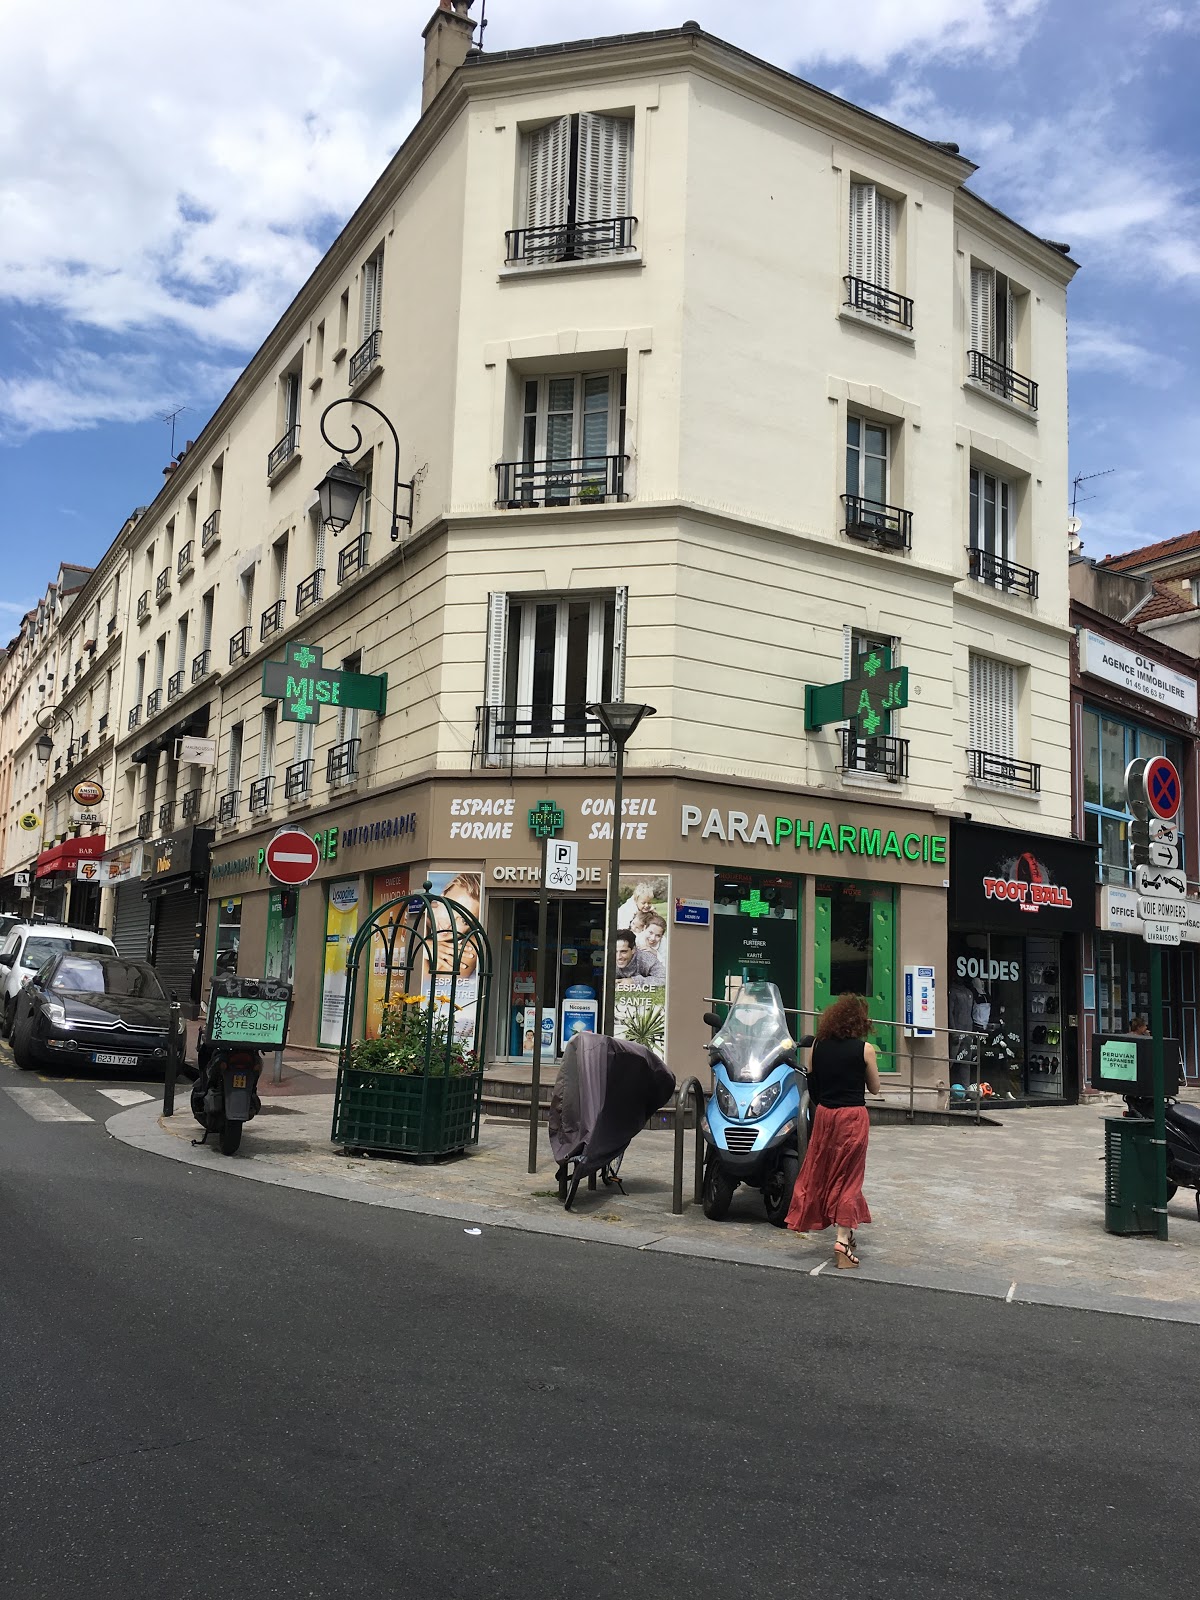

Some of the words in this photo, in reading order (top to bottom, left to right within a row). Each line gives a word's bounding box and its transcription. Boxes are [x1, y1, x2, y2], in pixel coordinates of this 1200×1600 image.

[1135, 656, 1156, 673] OLT
[1102, 654, 1135, 677] AGENCE
[1136, 669, 1186, 699] IMMOBILIERE
[1125, 677, 1133, 687] 01
[1133, 681, 1142, 691] 45
[450, 798, 516, 816] ESPACE
[80, 813, 97, 821] BAR
[341, 812, 417, 848] PHYTOTHERAPIE
[449, 821, 514, 840] FORME
[558, 847, 568, 861] P
[493, 866, 602, 882] ORTHDIE
[983, 876, 1028, 902] FOOT
[1030, 882, 1073, 909] BALL
[1110, 906, 1135, 918] OFFICE
[1142, 901, 1156, 915] VOIE
[1157, 902, 1187, 919] POMPIERS
[1155, 924, 1170, 933] SAUF
[1147, 932, 1179, 943] LIVRAISONS
[956, 955, 1020, 982] SOLDES
[435, 977, 470, 987] ESPCE
[617, 983, 656, 993] ESPACE
[619, 996, 653, 1006] SANTE
[1102, 1051, 1135, 1059] PERUVIAN
[1107, 1057, 1135, 1065] JAPANESE
